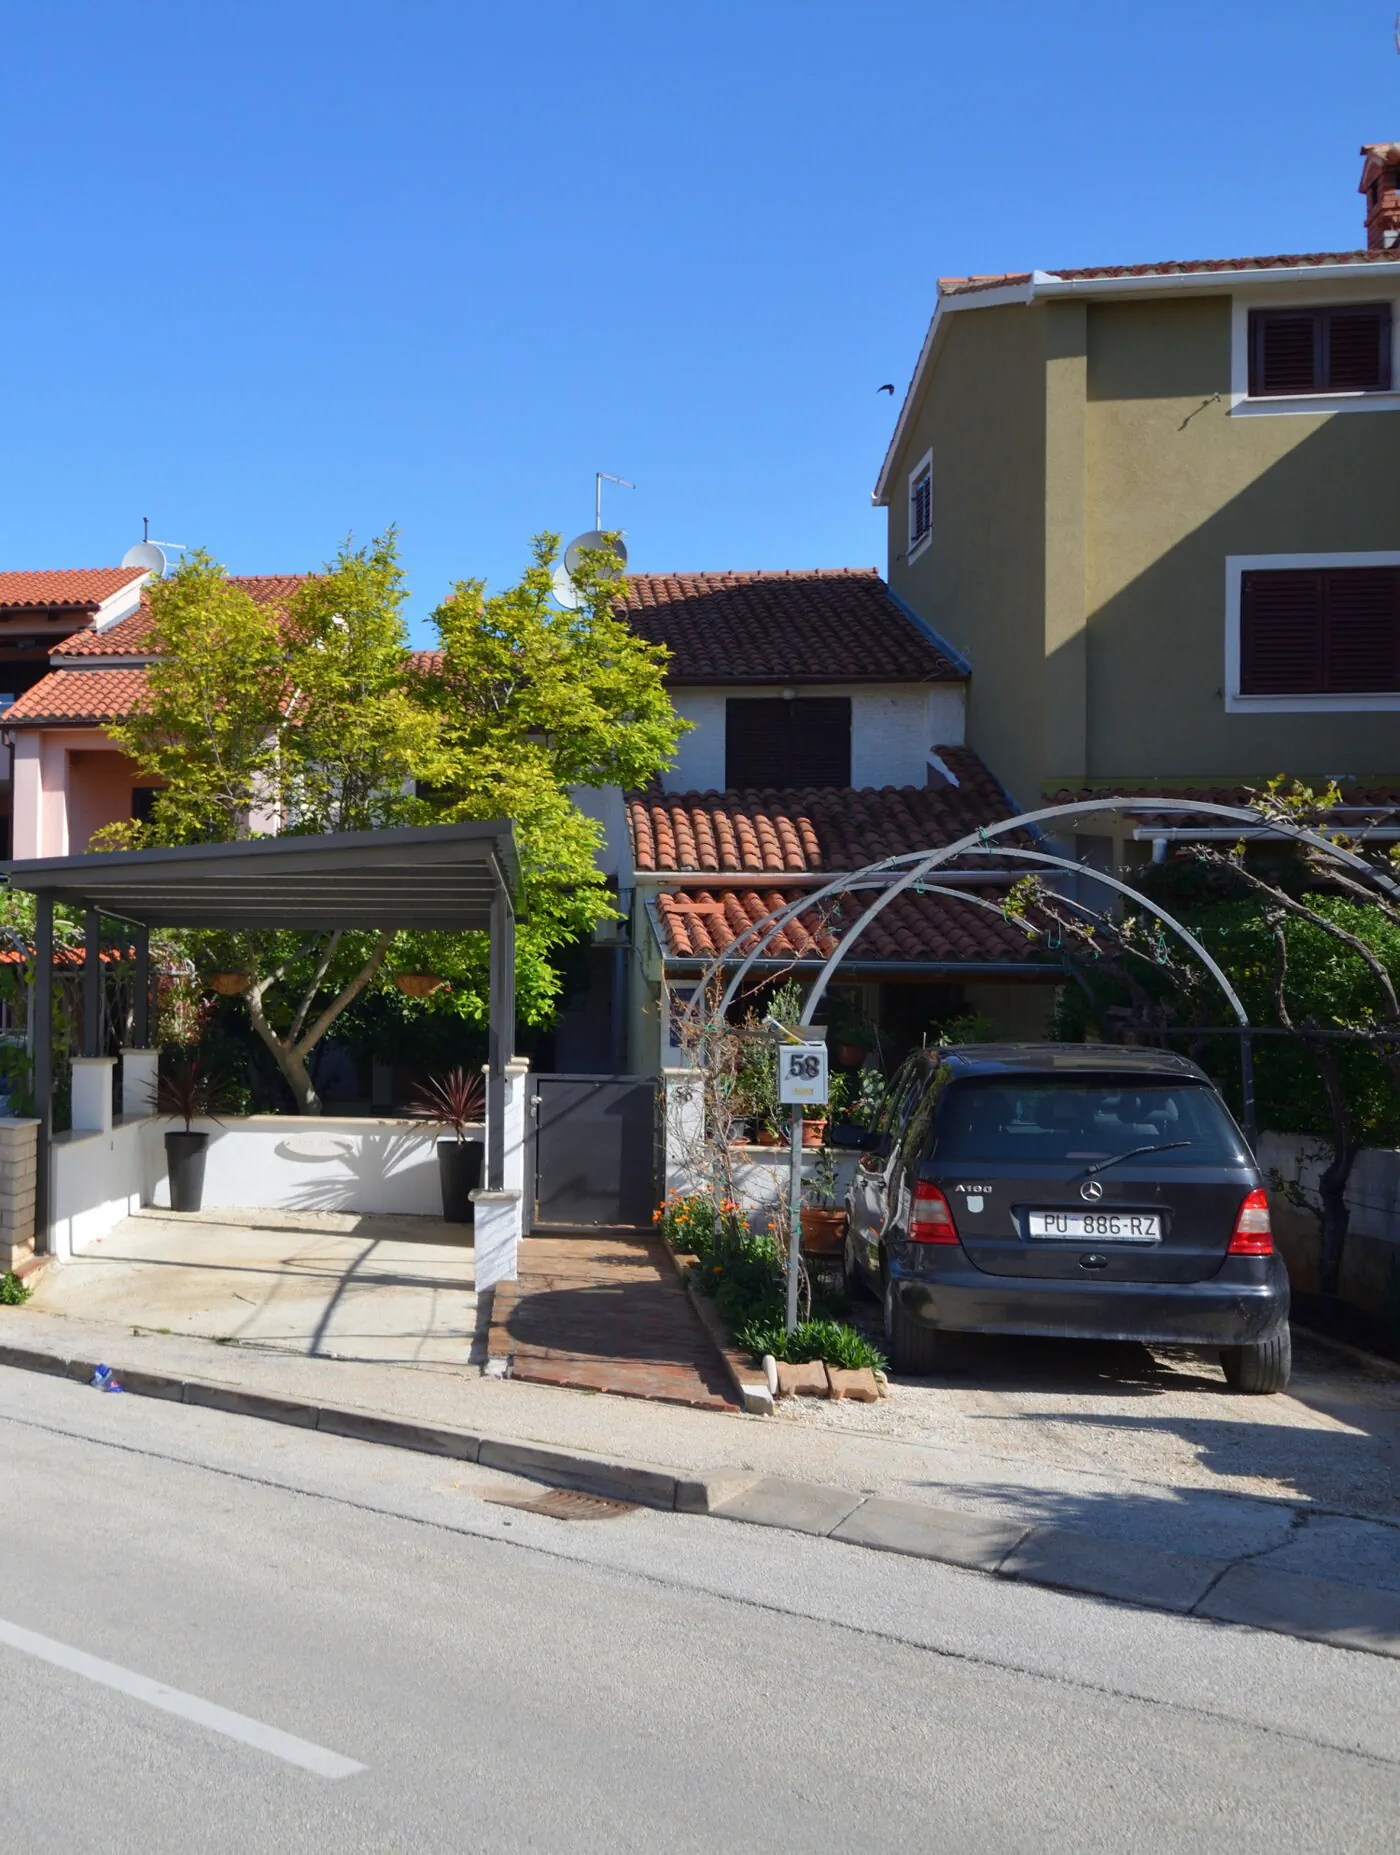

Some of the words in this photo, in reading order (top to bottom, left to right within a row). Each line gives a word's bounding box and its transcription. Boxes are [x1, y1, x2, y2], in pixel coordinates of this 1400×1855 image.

[790, 1054, 820, 1078] 58
[1044, 1215, 1068, 1233] PU
[1083, 1216, 1156, 1236] 886-RZ
